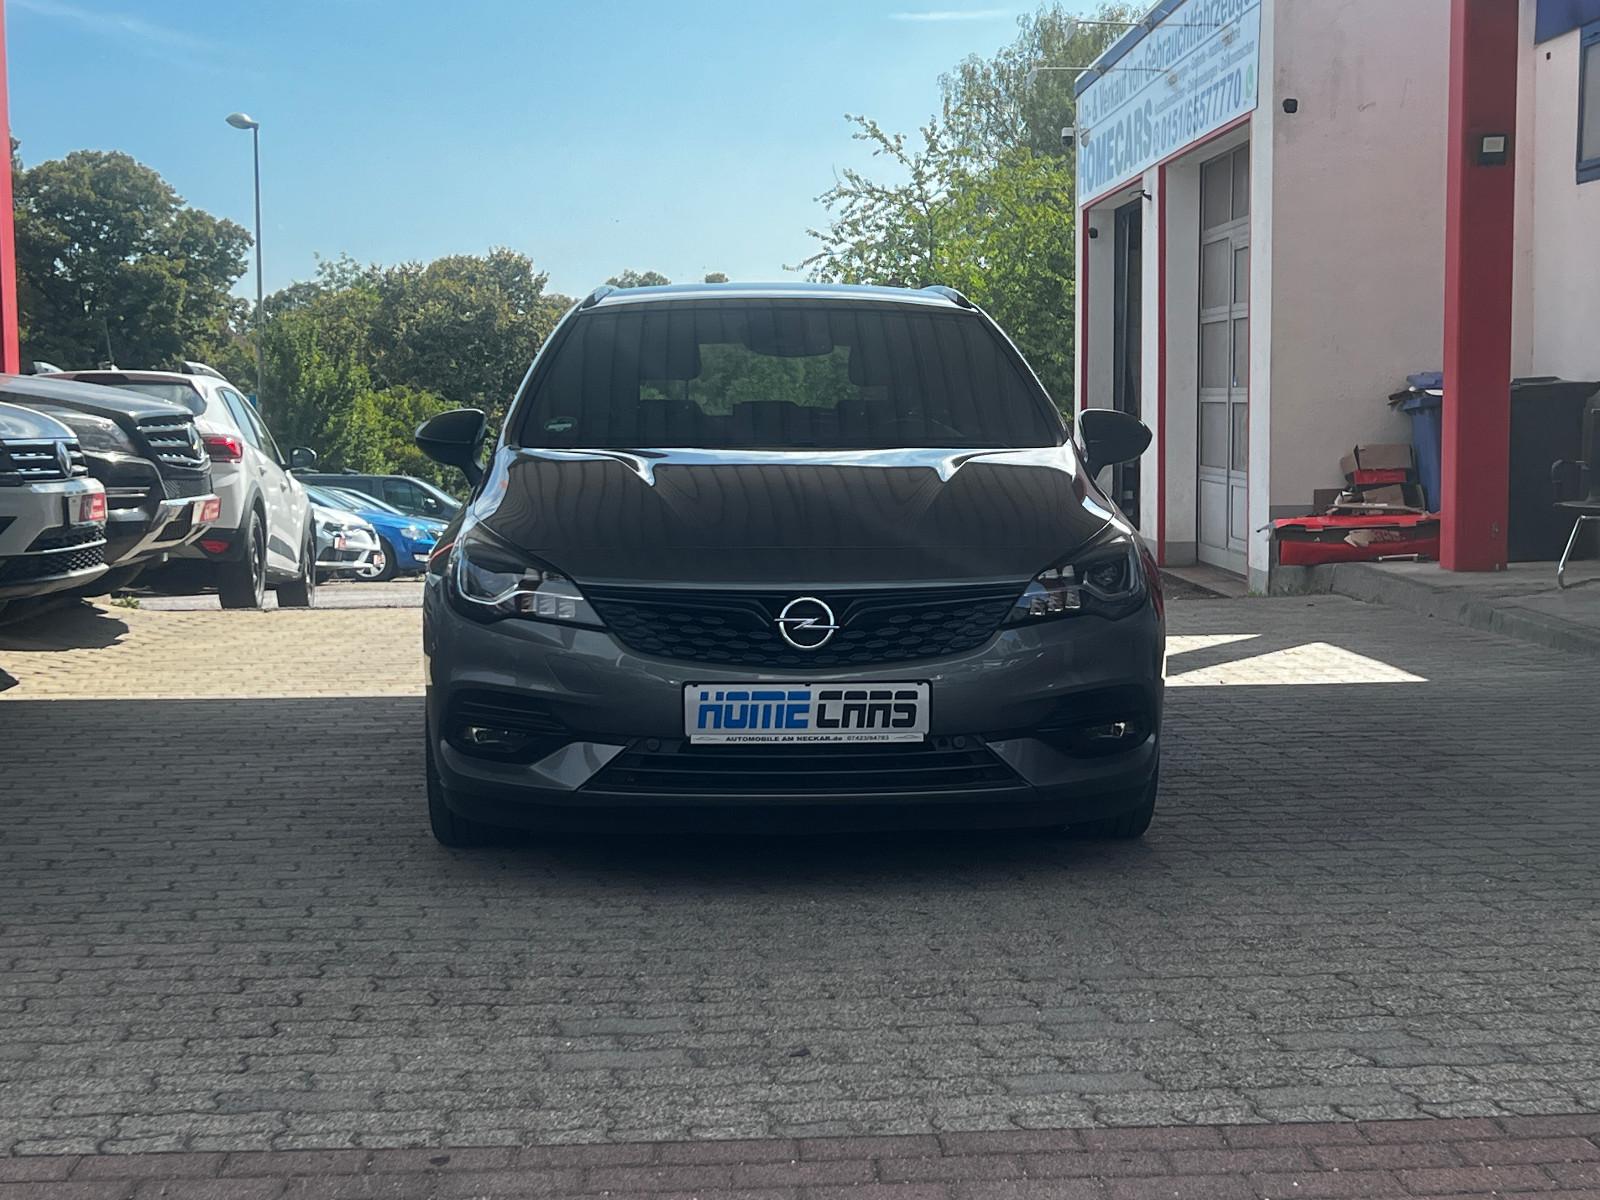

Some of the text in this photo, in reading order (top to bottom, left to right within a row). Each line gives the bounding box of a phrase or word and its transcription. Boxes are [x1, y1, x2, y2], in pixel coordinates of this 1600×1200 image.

[1099, 64, 1127, 114] Verkauf
[1129, 57, 1144, 96] von
[698, 690, 918, 729] HOME CARS
